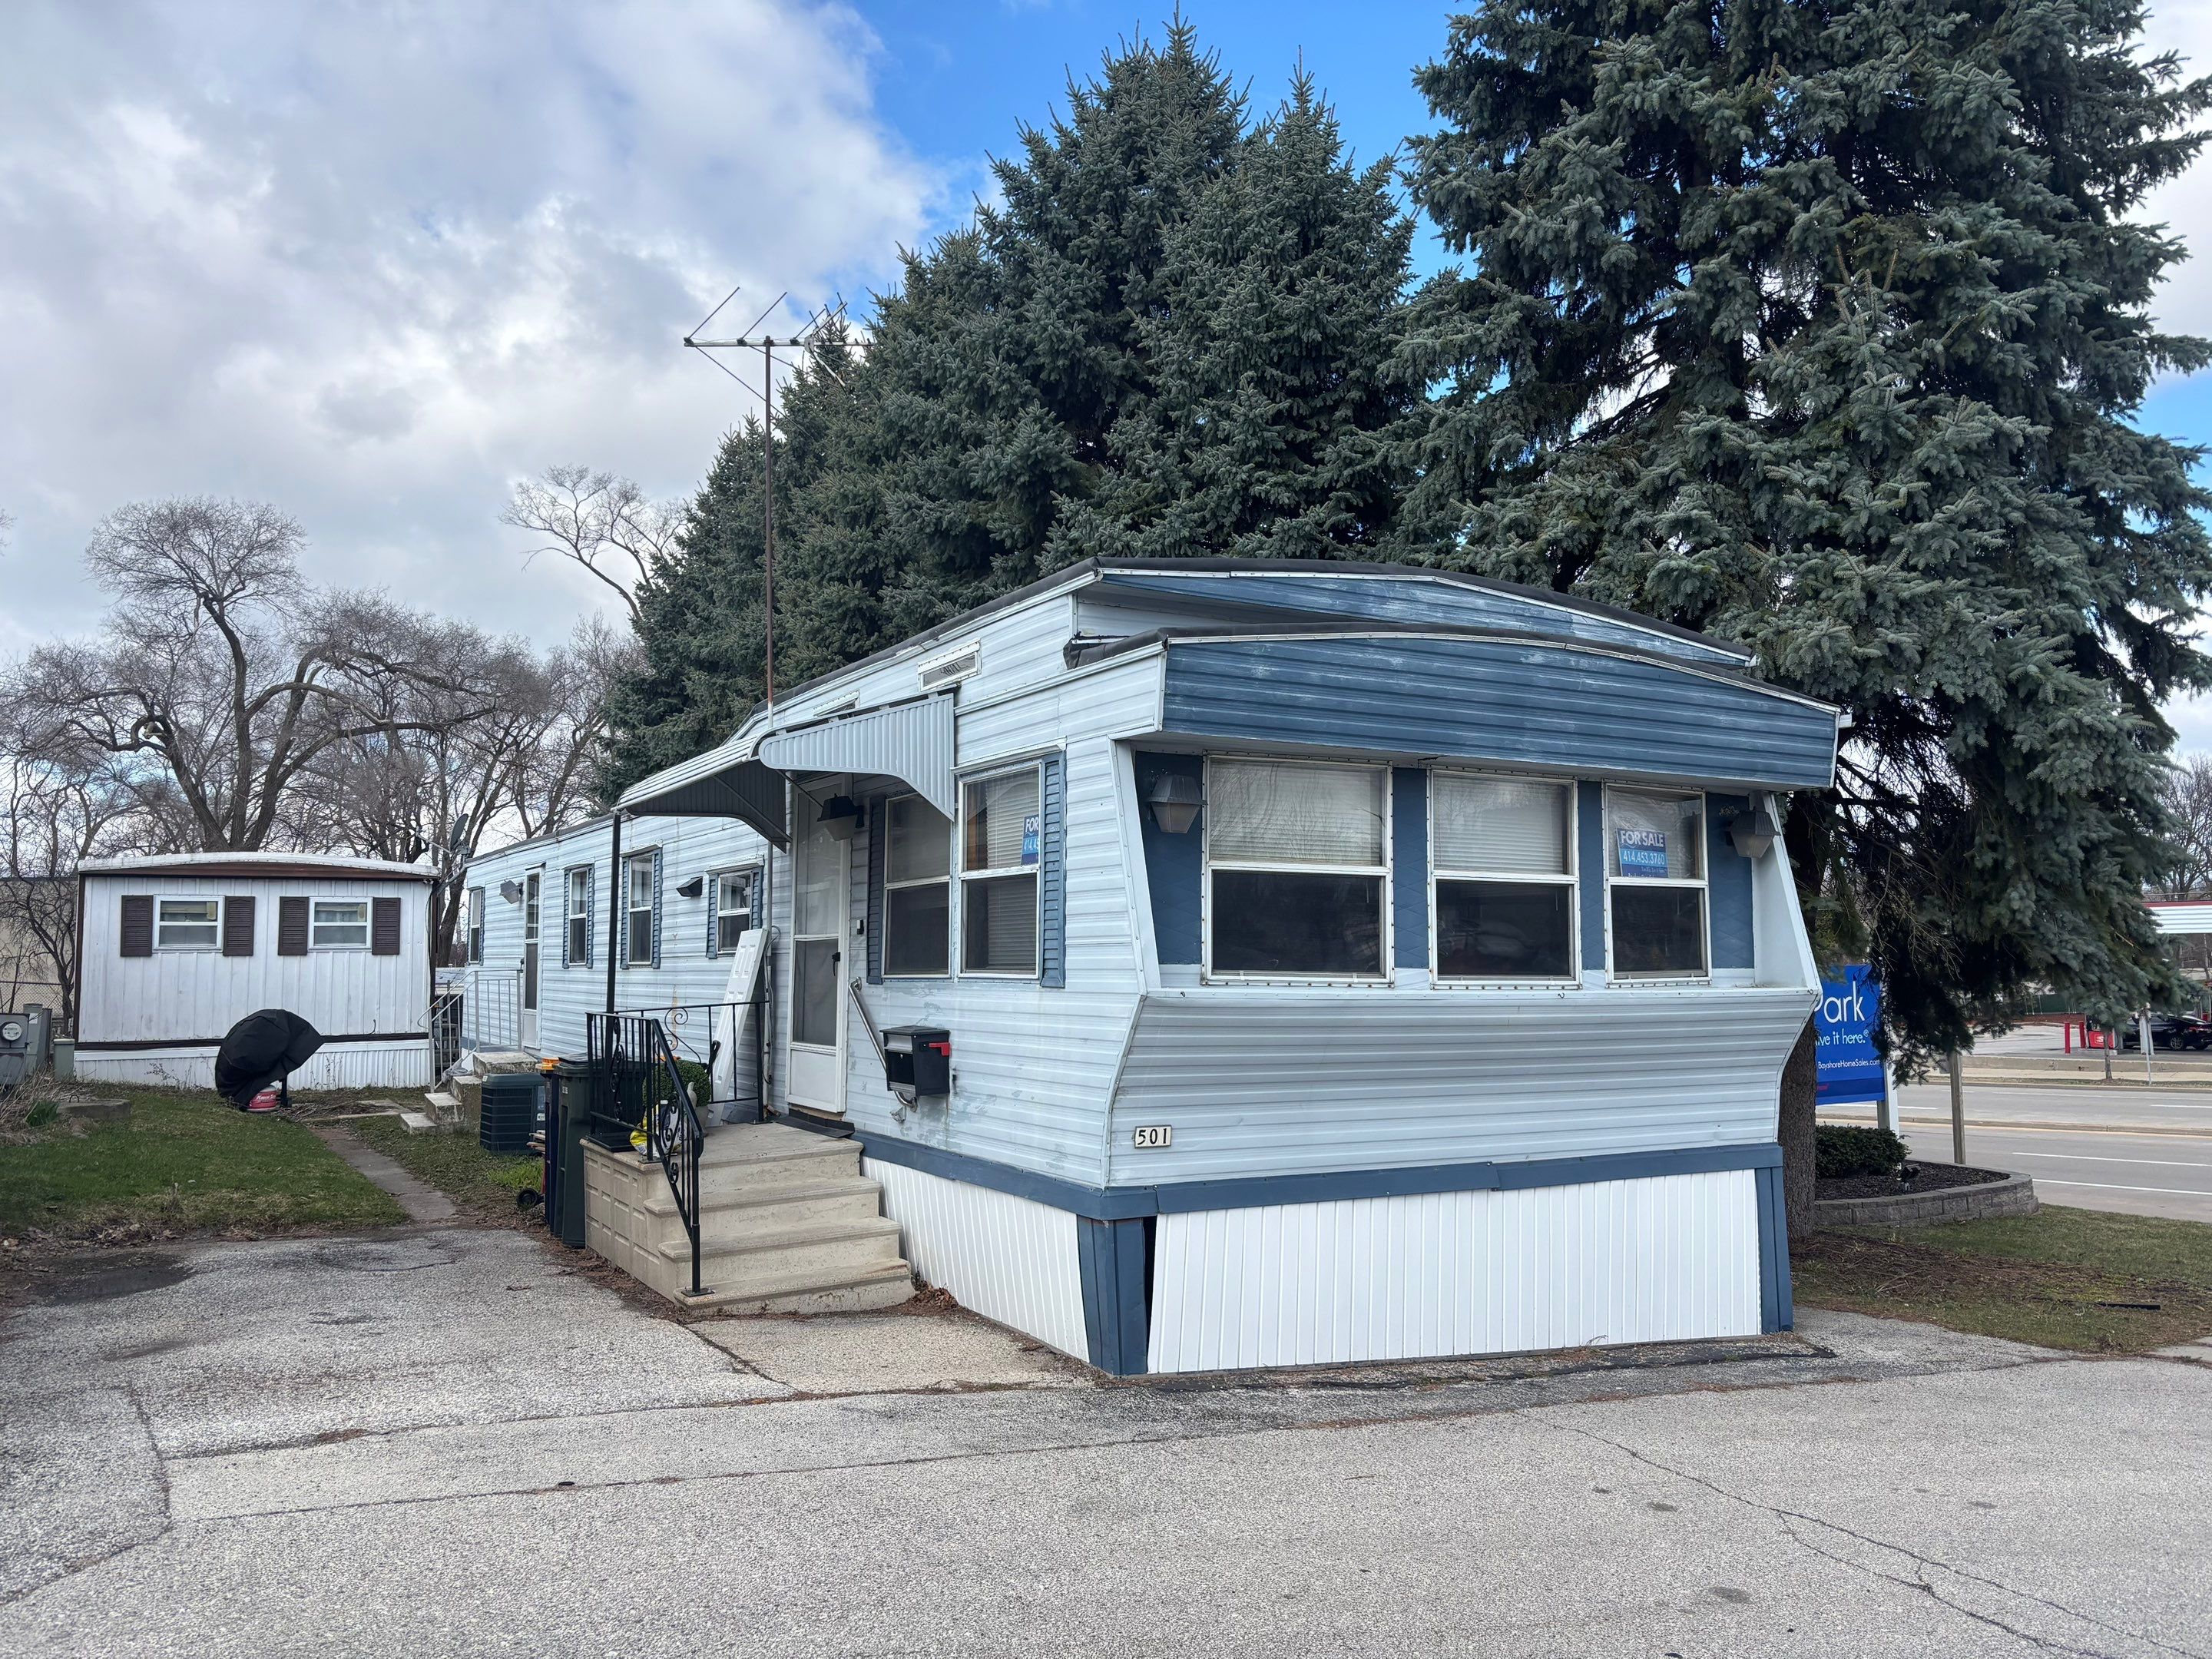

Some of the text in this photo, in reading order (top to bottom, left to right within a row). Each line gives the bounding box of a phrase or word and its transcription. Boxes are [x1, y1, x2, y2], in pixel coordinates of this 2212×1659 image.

[1025, 816, 1039, 833] FOR
[1621, 830, 1664, 847] FOR SALE
[1623, 850, 1665, 865] 414.453.3760
[1833, 1031, 1839, 1045] it
[1818, 1058, 1881, 1071] BayshoreHomeSales.com
[1137, 1128, 1167, 1145] 501
